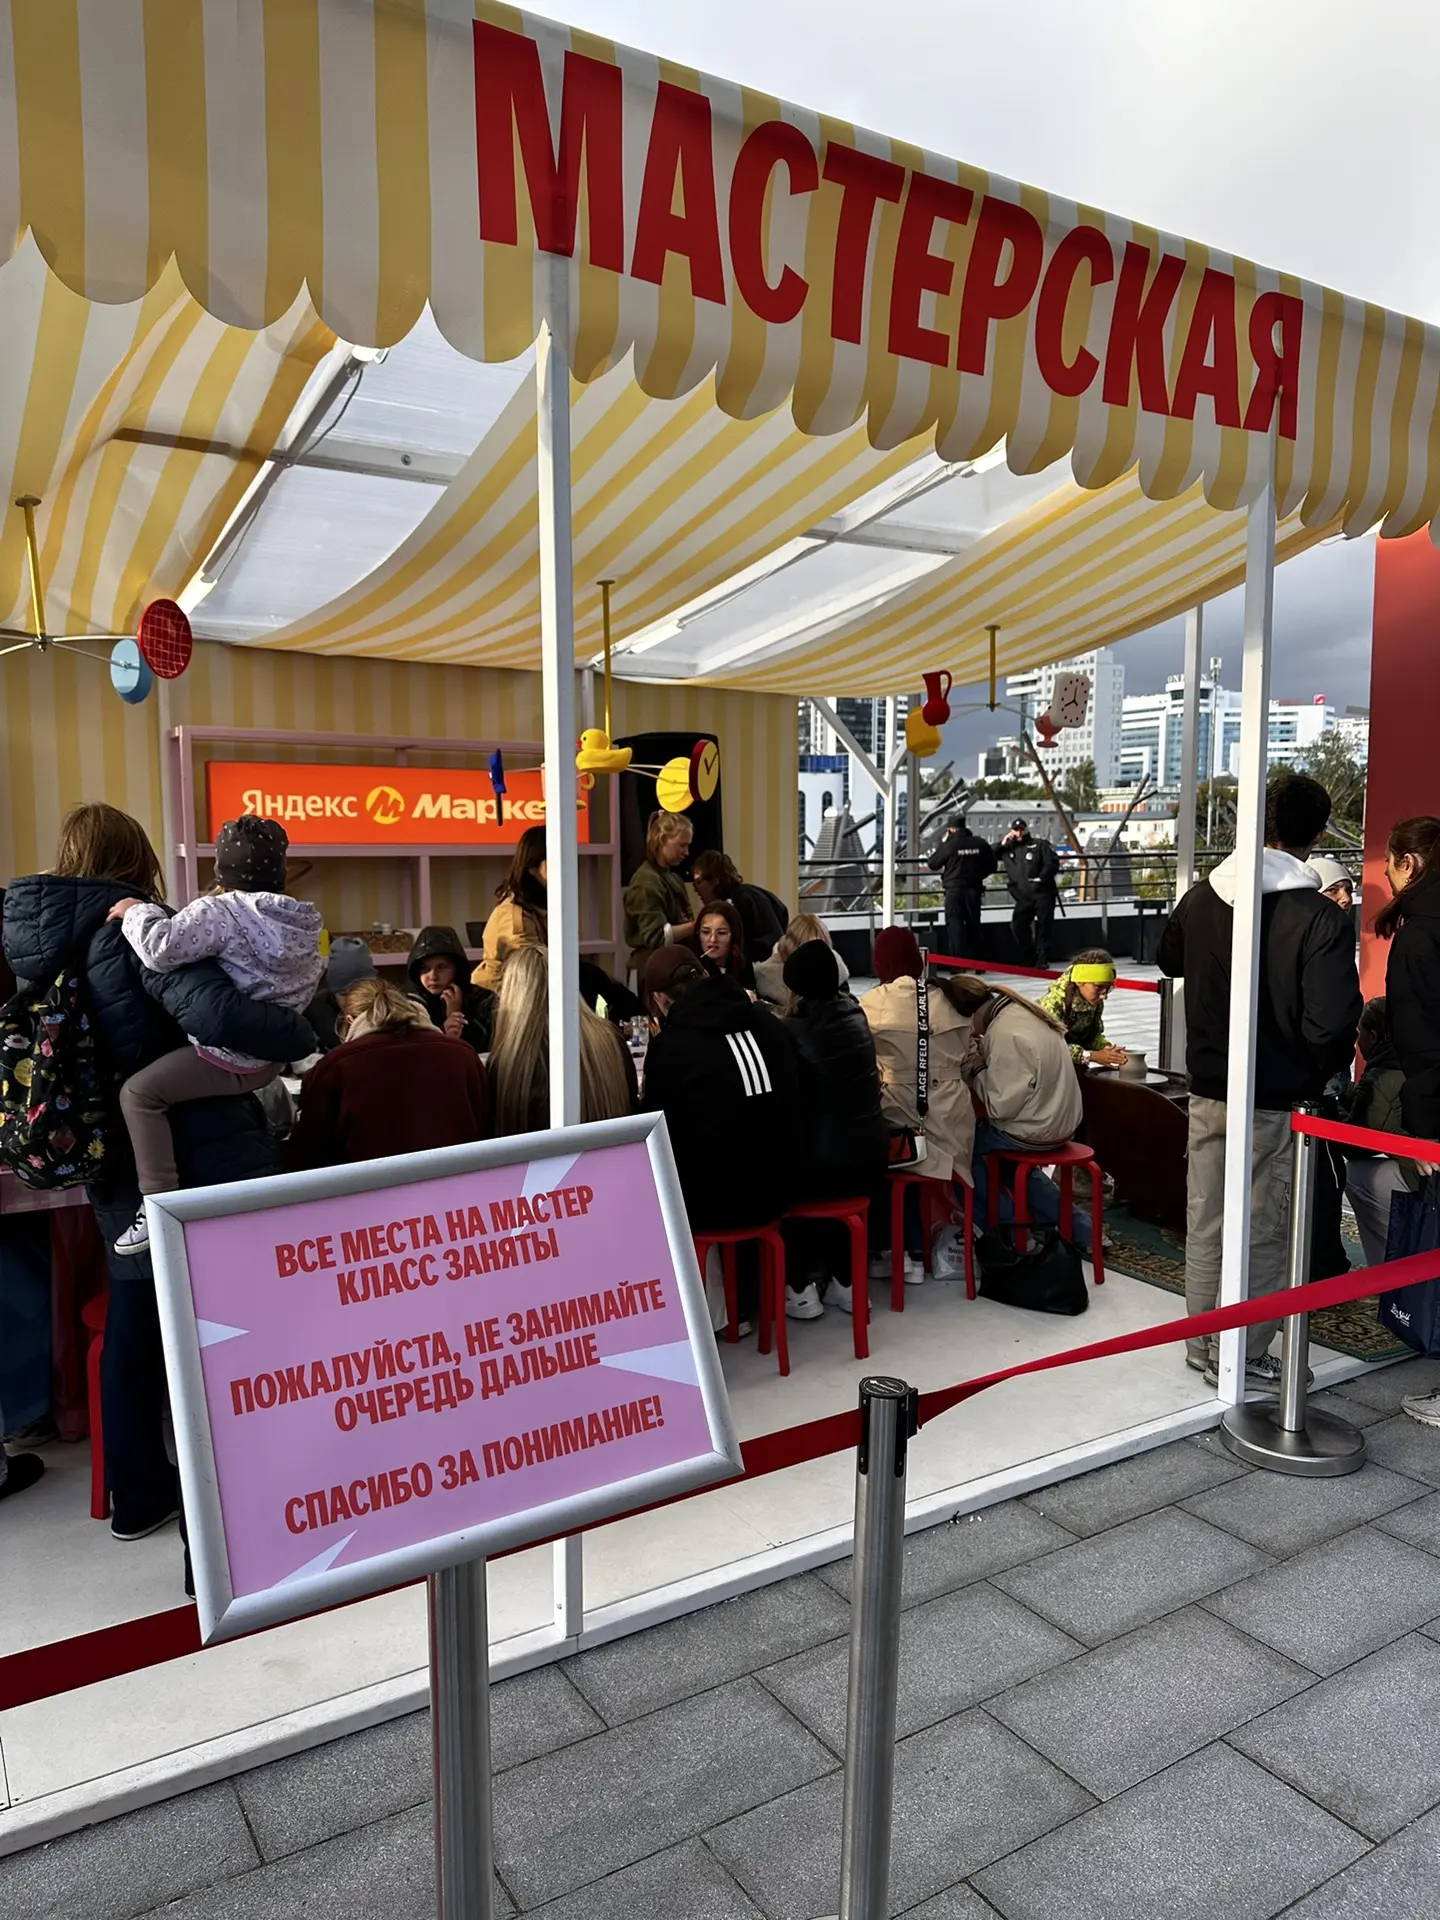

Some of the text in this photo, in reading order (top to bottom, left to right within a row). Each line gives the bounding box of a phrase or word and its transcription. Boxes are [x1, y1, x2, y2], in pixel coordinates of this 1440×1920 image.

[472, 19, 1303, 441] МАСТЕРСКАЯ
[242, 789, 358, 820] Яндекс
[411, 793, 546, 824] Марке
[919, 994, 928, 1017] KARL
[275, 1185, 594, 1277] ВСЕ МЕСТА НА МАСТЕР
[337, 1228, 560, 1306] КЛАСС ЗАНЯТЫ
[230, 1279, 666, 1415] ПОЖАЛУЙСТА, НЕ ЗАНИМАЙТЕ
[334, 1333, 600, 1432] ОЧЕРЕДЬ ДАЛЬШЕ
[285, 1395, 665, 1534] СПАСИБО ЗА ПОНИМАНИЕ!
